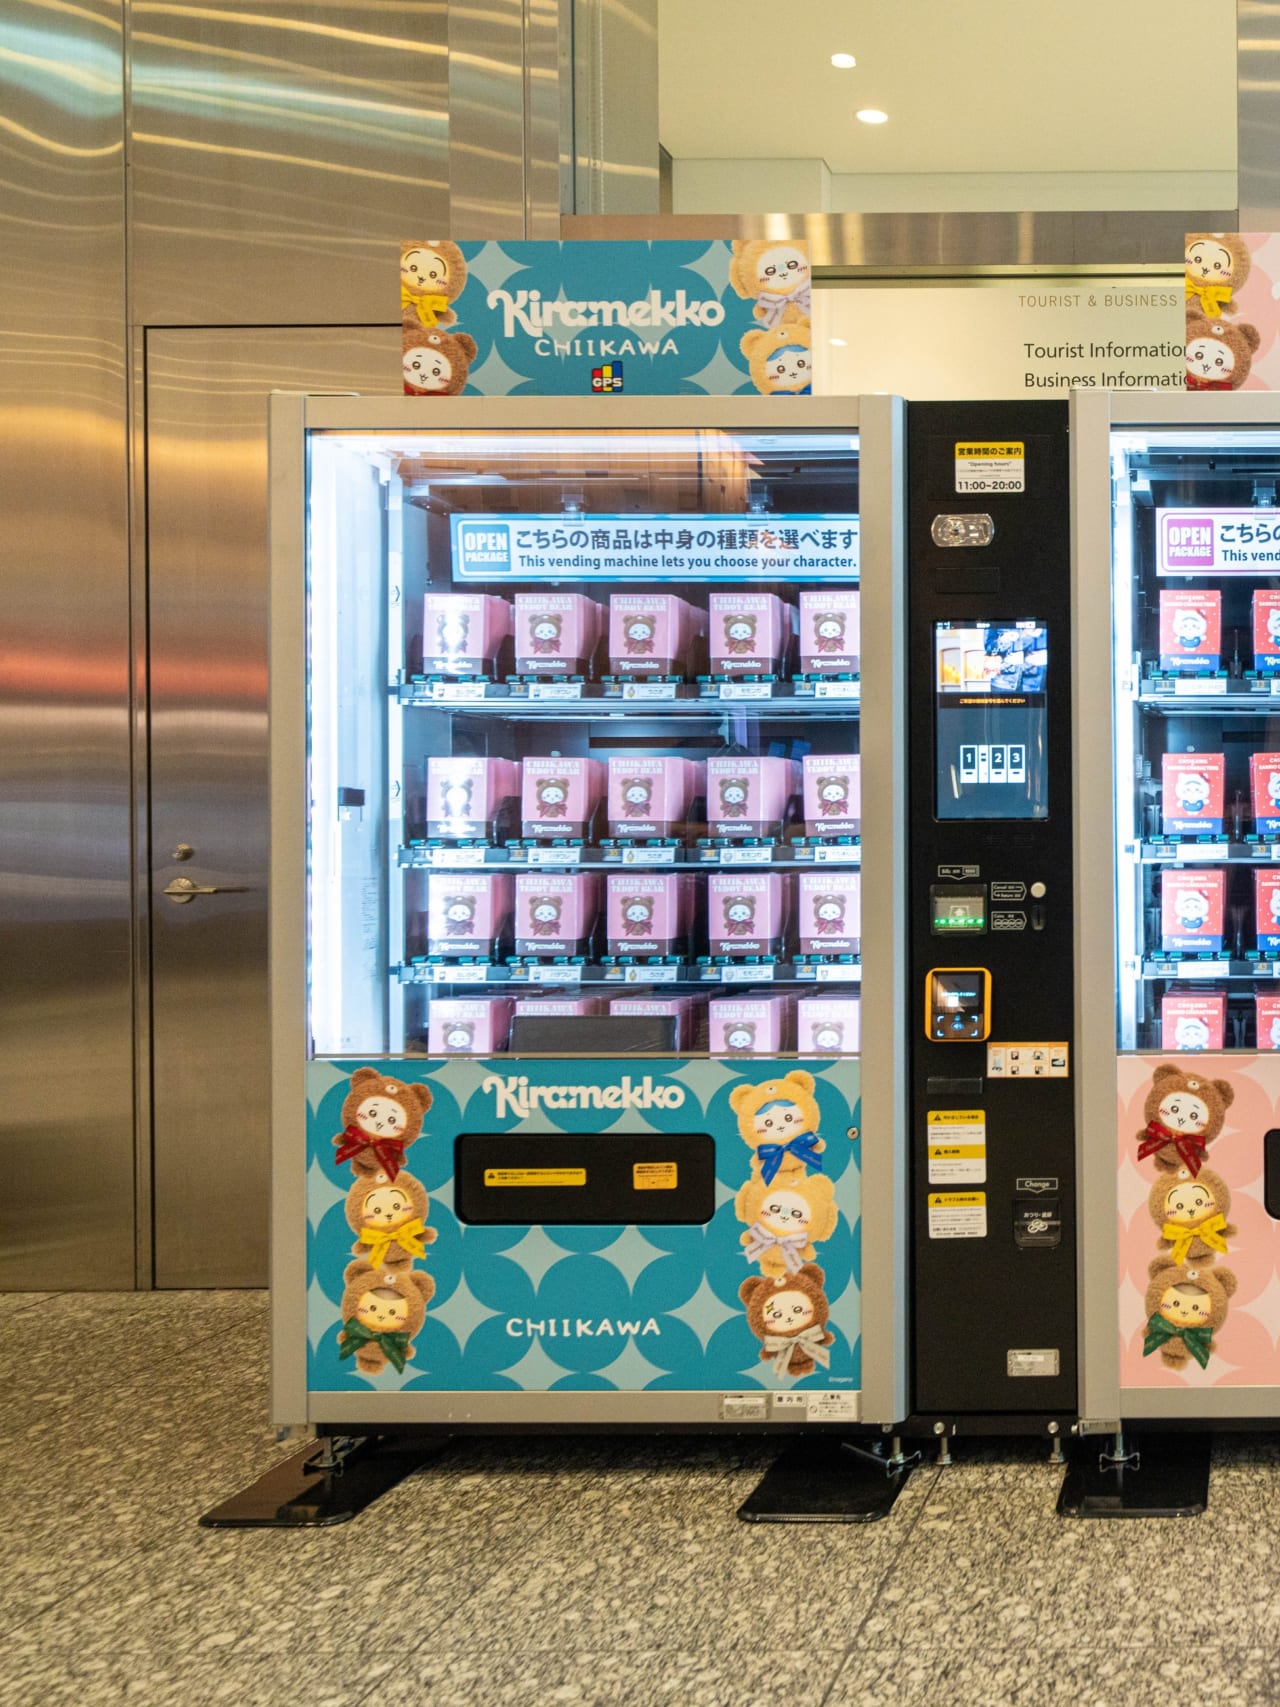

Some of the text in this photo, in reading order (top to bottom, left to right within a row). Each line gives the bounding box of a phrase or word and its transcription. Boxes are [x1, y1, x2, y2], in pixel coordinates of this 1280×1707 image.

[1018, 294, 1178, 308] TOURIST & BUSINESS
[486, 290, 725, 338] Kiramekko
[535, 338, 679, 356] CHIIKAWA
[1024, 341, 1187, 358] Tourist Informatio
[592, 376, 622, 388] GPS
[1025, 371, 1188, 388] Business Informati
[464, 532, 508, 551] OPEN
[516, 529, 858, 550] こちらの商品は中身の種類を選べます
[1168, 527, 1212, 546] OPEN
[466, 552, 509, 563] PACKAGE
[1169, 546, 1212, 557] PACKAGE
[1222, 550, 1248, 562] This
[518, 555, 856, 570] This vending machine lets you choose your character.
[966, 753, 1020, 762] 1 2 3
[482, 1076, 685, 1118] Kiramekko
[506, 1317, 662, 1338] CHIIKAWA
